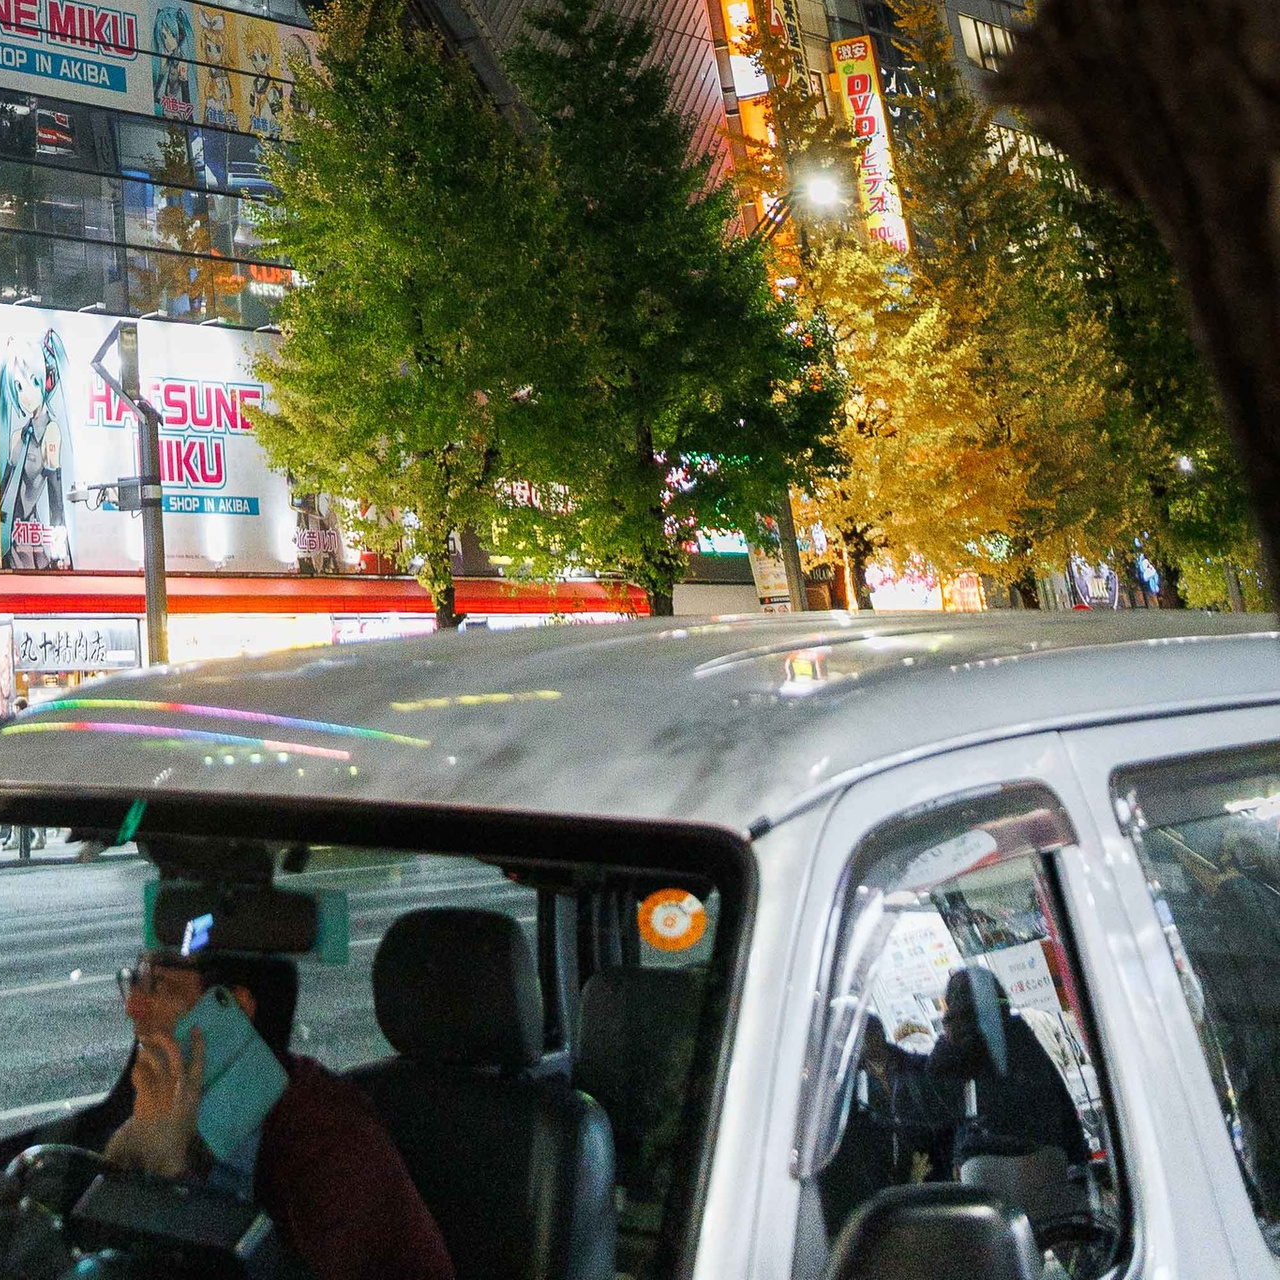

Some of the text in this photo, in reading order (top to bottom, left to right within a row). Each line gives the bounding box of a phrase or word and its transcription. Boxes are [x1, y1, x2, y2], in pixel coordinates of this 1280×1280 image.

[838, 42, 867, 60] 激安
[35, 53, 53, 74] IN
[59, 58, 111, 87] AKIBA
[169, 497, 200, 512] SHOP
[203, 498, 215, 512] IN
[218, 498, 251, 514] AKIBA
